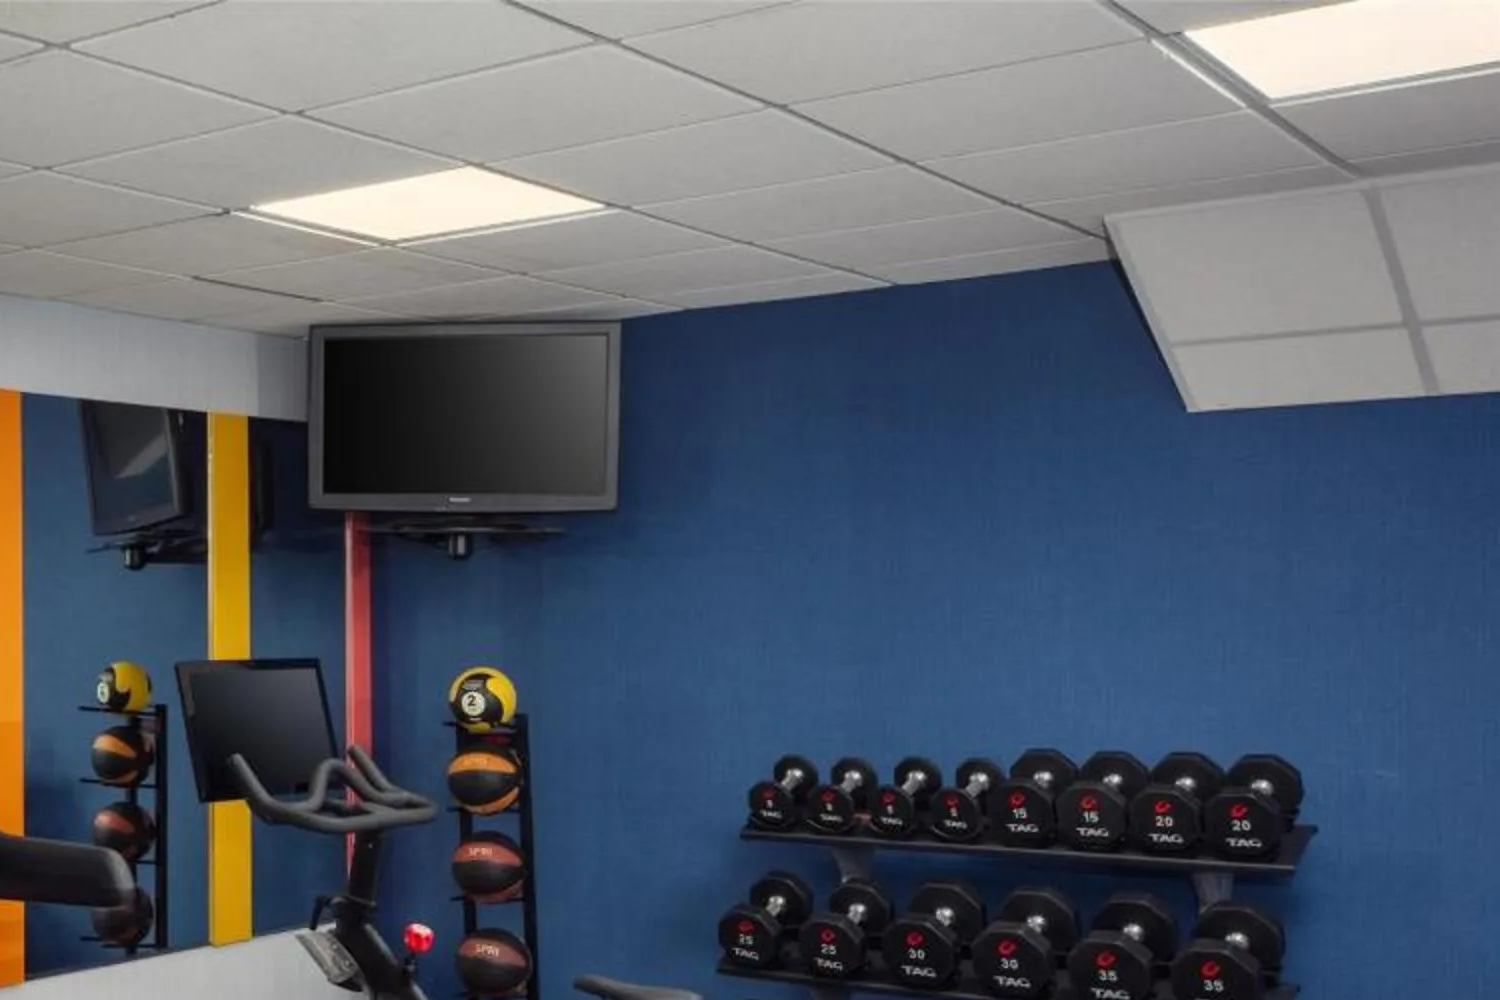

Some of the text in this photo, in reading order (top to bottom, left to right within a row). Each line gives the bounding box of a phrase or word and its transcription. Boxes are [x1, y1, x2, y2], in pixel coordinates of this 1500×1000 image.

[467, 694, 477, 707] 2
[1012, 807, 1028, 819] 15
[1083, 811, 1100, 823] 15
[1007, 823, 1039, 833] TAG
[1155, 815, 1174, 828] 20
[1231, 819, 1252, 832] 20
[1075, 827, 1109, 837] TAG
[1148, 833, 1184, 844] TAG
[1226, 837, 1262, 848] TAG
[732, 947, 759, 961] TAG
[821, 943, 837, 955] 25
[815, 957, 844, 971] TAG
[901, 965, 936, 978] TAG
[1099, 969, 1118, 982] 35
[994, 975, 1031, 989] TAG
[1203, 979, 1224, 992] 35
[1091, 987, 1130, 1000] TAG
